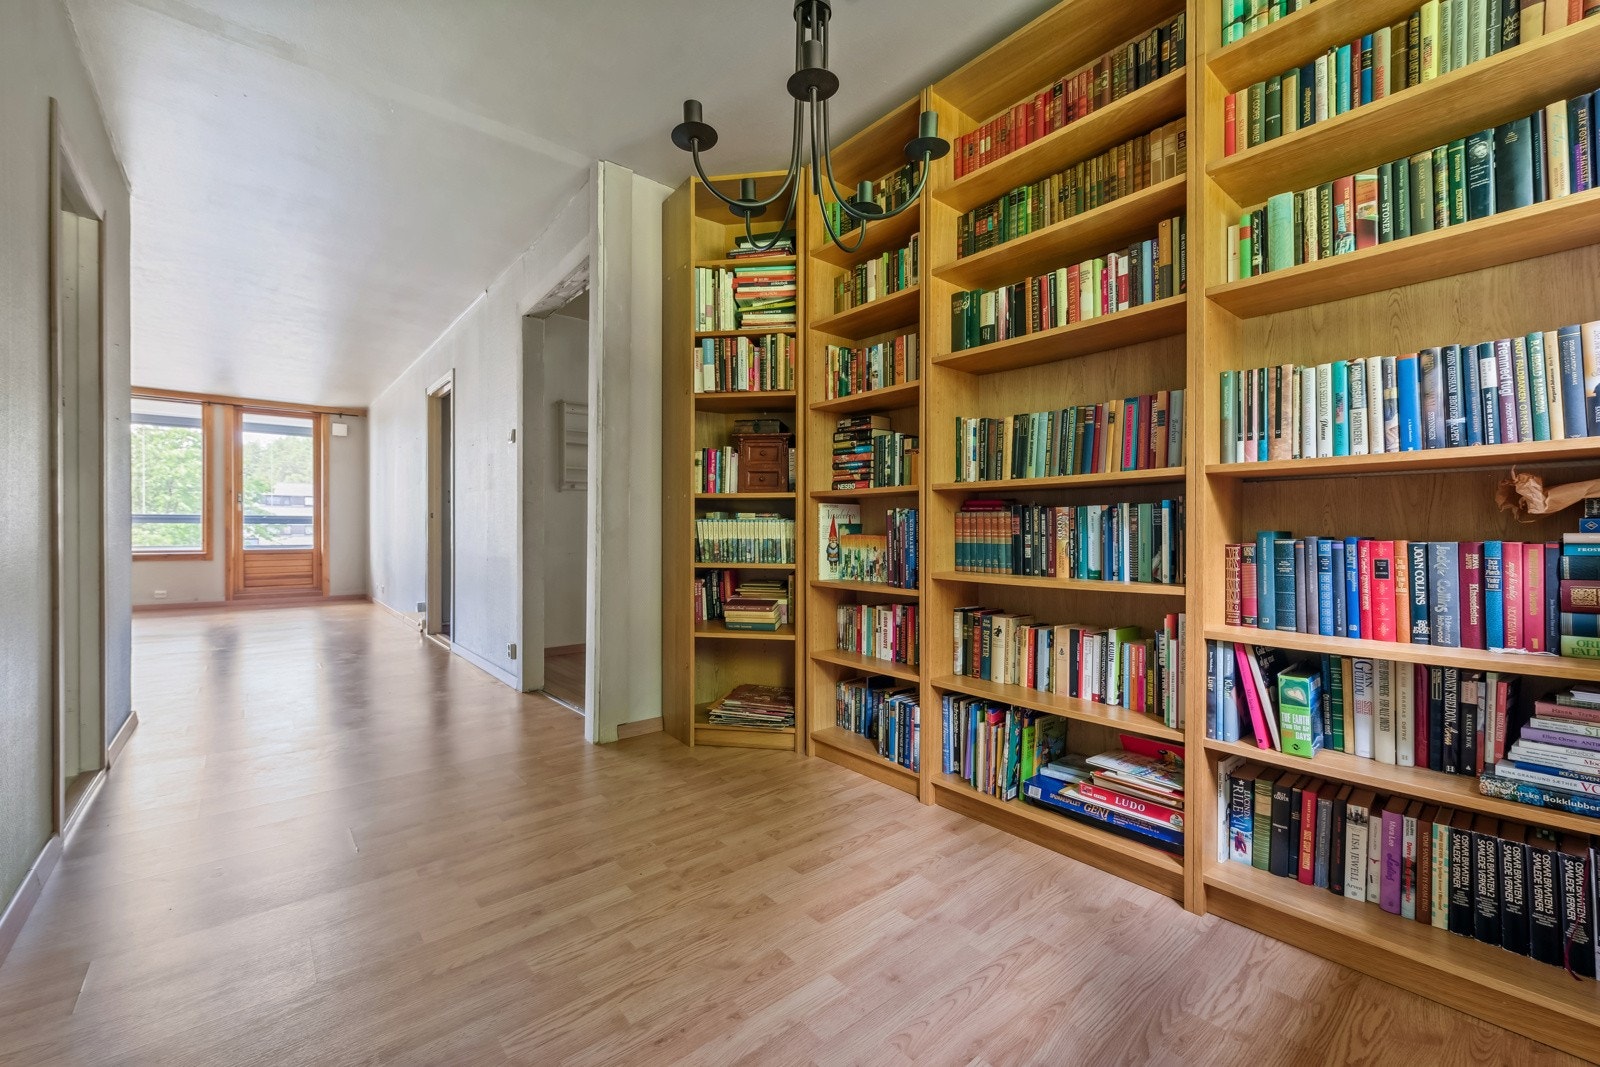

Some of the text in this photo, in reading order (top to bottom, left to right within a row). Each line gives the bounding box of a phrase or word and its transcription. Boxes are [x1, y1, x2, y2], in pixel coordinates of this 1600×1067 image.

[1578, 109, 1588, 183] ERIK FOSNES HANSEN
[1321, 217, 1329, 248] LEONARD
[1382, 202, 1390, 234] STONER
[1447, 350, 1456, 366] JOHN
[1498, 341, 1513, 396] Fremmed fugl
[1514, 338, 1529, 434] KNUT FALDBAKKEN ORMENS
[1353, 412, 1362, 445] PARTNEREN
[1449, 395, 1459, 441] BRODERKAPET
[1413, 546, 1426, 605] JOAN COLLINS
[1434, 545, 1451, 612] Jackie Collins
[1469, 584, 1479, 625] Klassefesten
[1436, 615, 1445, 643] Hollywood
[1354, 661, 1373, 696] GUILLOU
[1445, 669, 1456, 723] SIDNEY SHELDON
[1281, 713, 1310, 725] THE EARTH
[1296, 732, 1311, 741] DAYS
[1517, 772, 1550, 782] GRANLUND
[1553, 778, 1577, 786] SÆTHER
[1083, 804, 1110, 821] GENI
[1115, 797, 1146, 812] LUDO
[1233, 784, 1243, 820] RILEY
[1350, 851, 1359, 882] JEWELL
[1477, 839, 1486, 895] SAMLEDE VERKER
[1486, 841, 1494, 862] OSKAR
[1542, 855, 1550, 877] OSKAR
[1504, 845, 1513, 902] SAMLEDE VERKER
[1514, 869, 1522, 899] BRAATEN
[1532, 852, 1543, 911] SAMLEDE VERKER
[1575, 862, 1584, 886] OSKAR
[1544, 878, 1552, 908] BRAATEN
[1564, 860, 1576, 920] SAMLEDE VERKER
